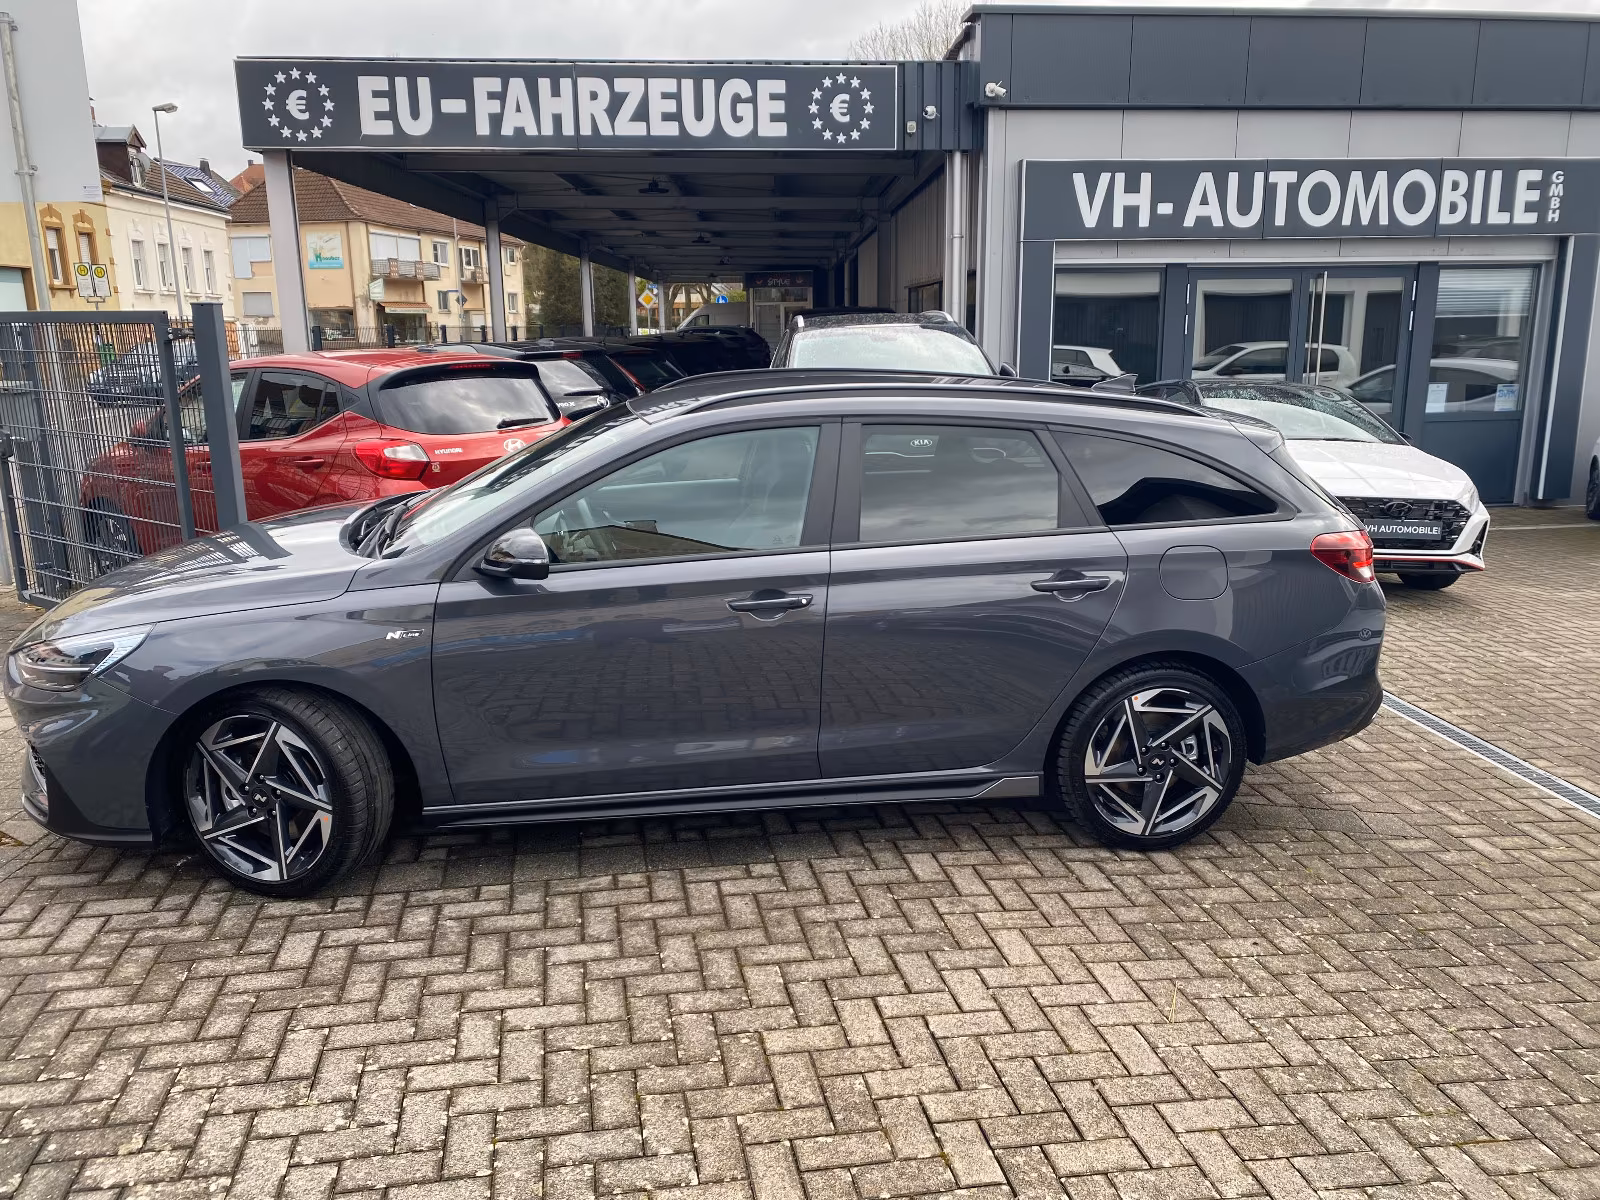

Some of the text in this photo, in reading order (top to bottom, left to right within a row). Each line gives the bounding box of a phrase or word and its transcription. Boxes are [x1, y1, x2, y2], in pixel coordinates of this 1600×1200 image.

[356, 75, 788, 138] EU-FAHRZEUGE
[1547, 170, 1565, 222] GMBH
[434, 447, 464, 455] HYUNDAI
[1365, 524, 1378, 533] VH
[1379, 525, 1438, 535] AUTOMOBILE
